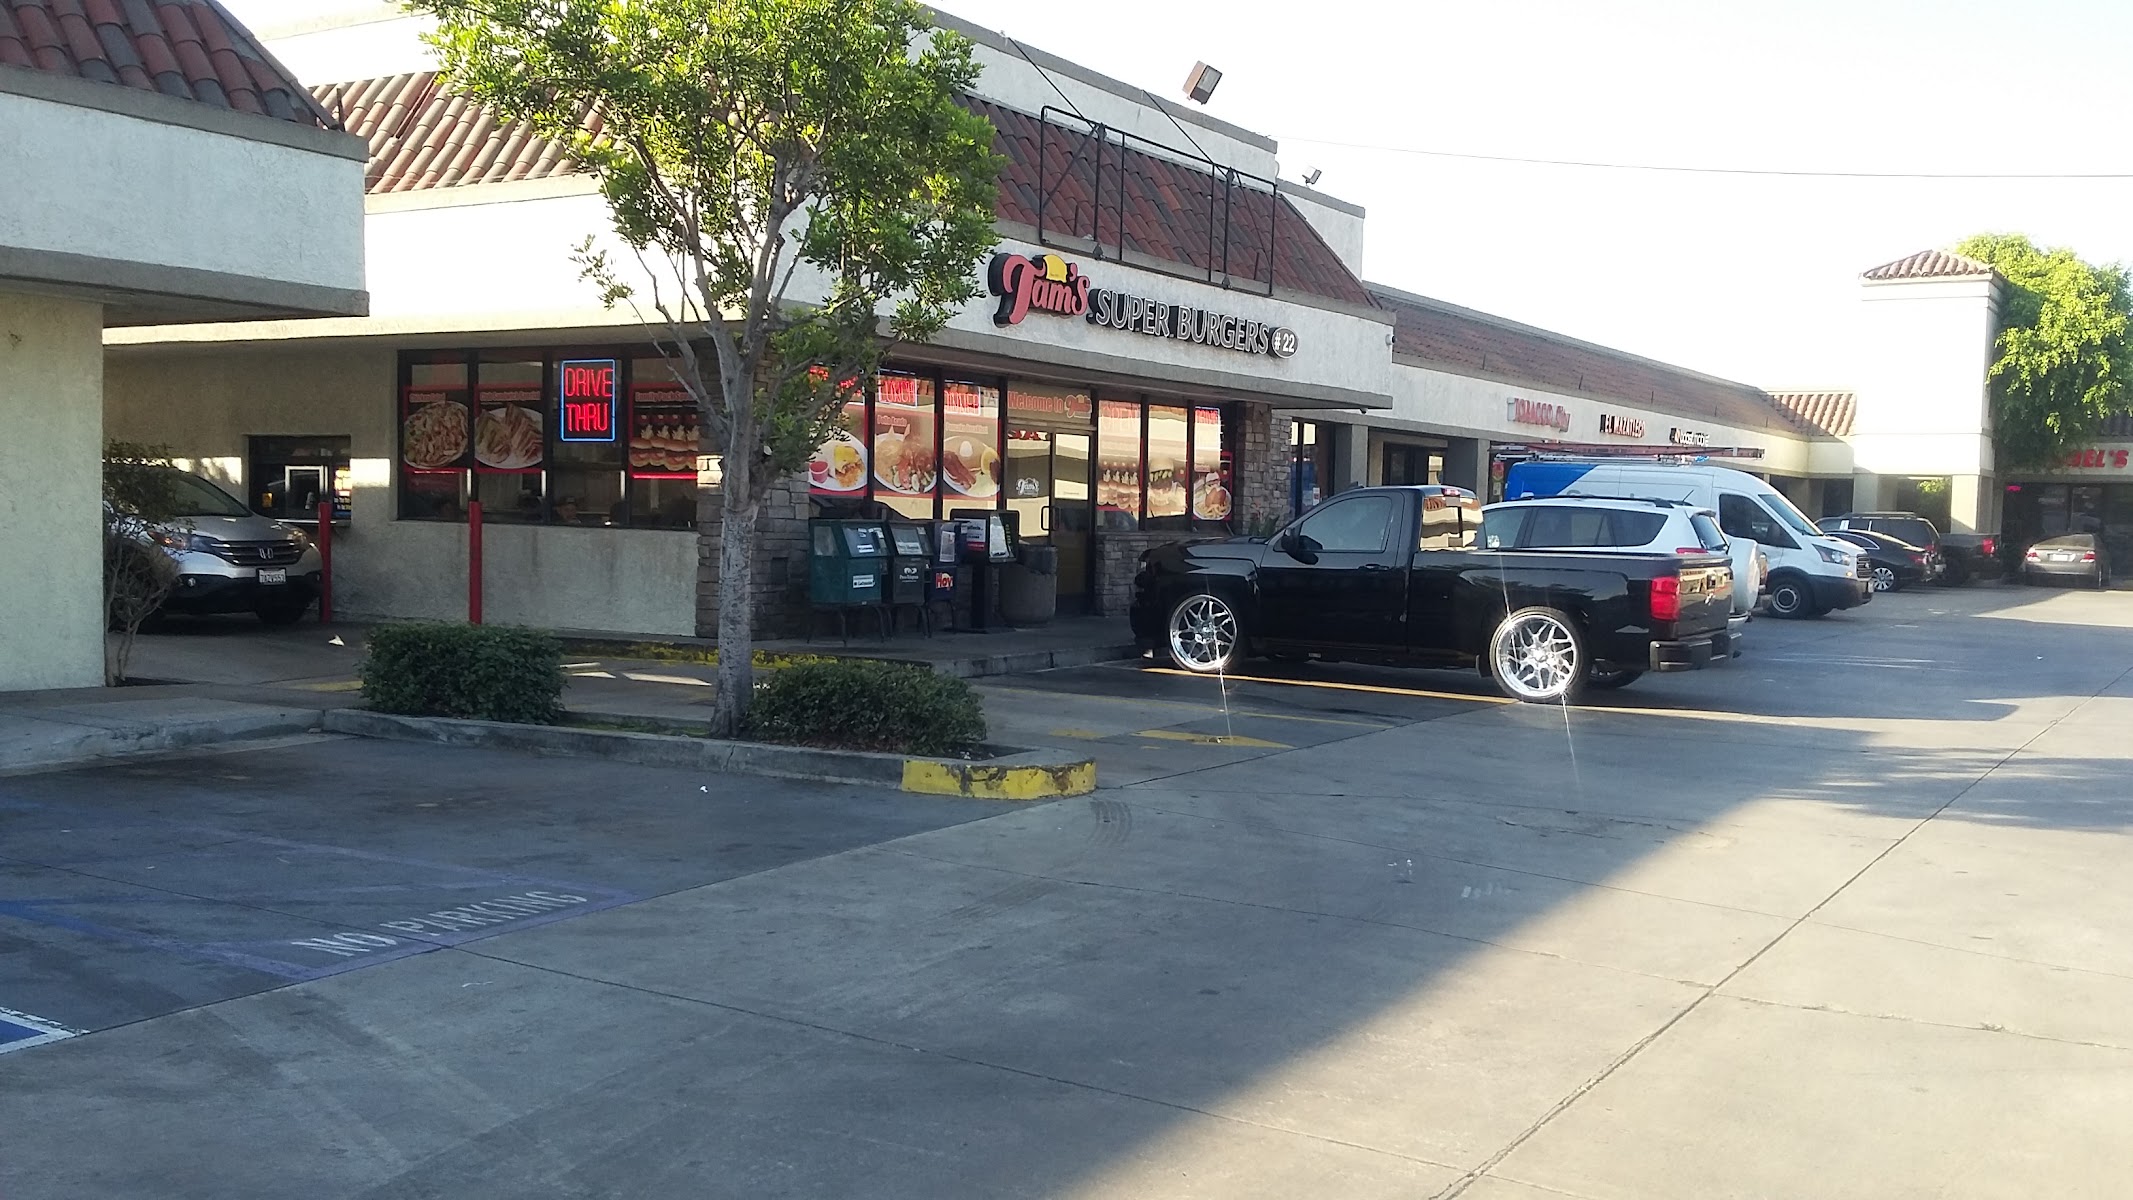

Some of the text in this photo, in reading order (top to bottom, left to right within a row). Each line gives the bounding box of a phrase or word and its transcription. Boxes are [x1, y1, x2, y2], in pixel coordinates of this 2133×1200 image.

[1001, 253, 1296, 355] Tam's SUPER BURGERS #22
[564, 367, 614, 397] DRIVE
[880, 378, 916, 403] LUNCH
[1008, 391, 1053, 413] Welcome
[1053, 396, 1064, 414] to
[1511, 397, 1553, 425] TOBACCO
[565, 403, 609, 432] THRU
[936, 572, 953, 590] Hoy
[290, 890, 588, 957] NO PARKING
